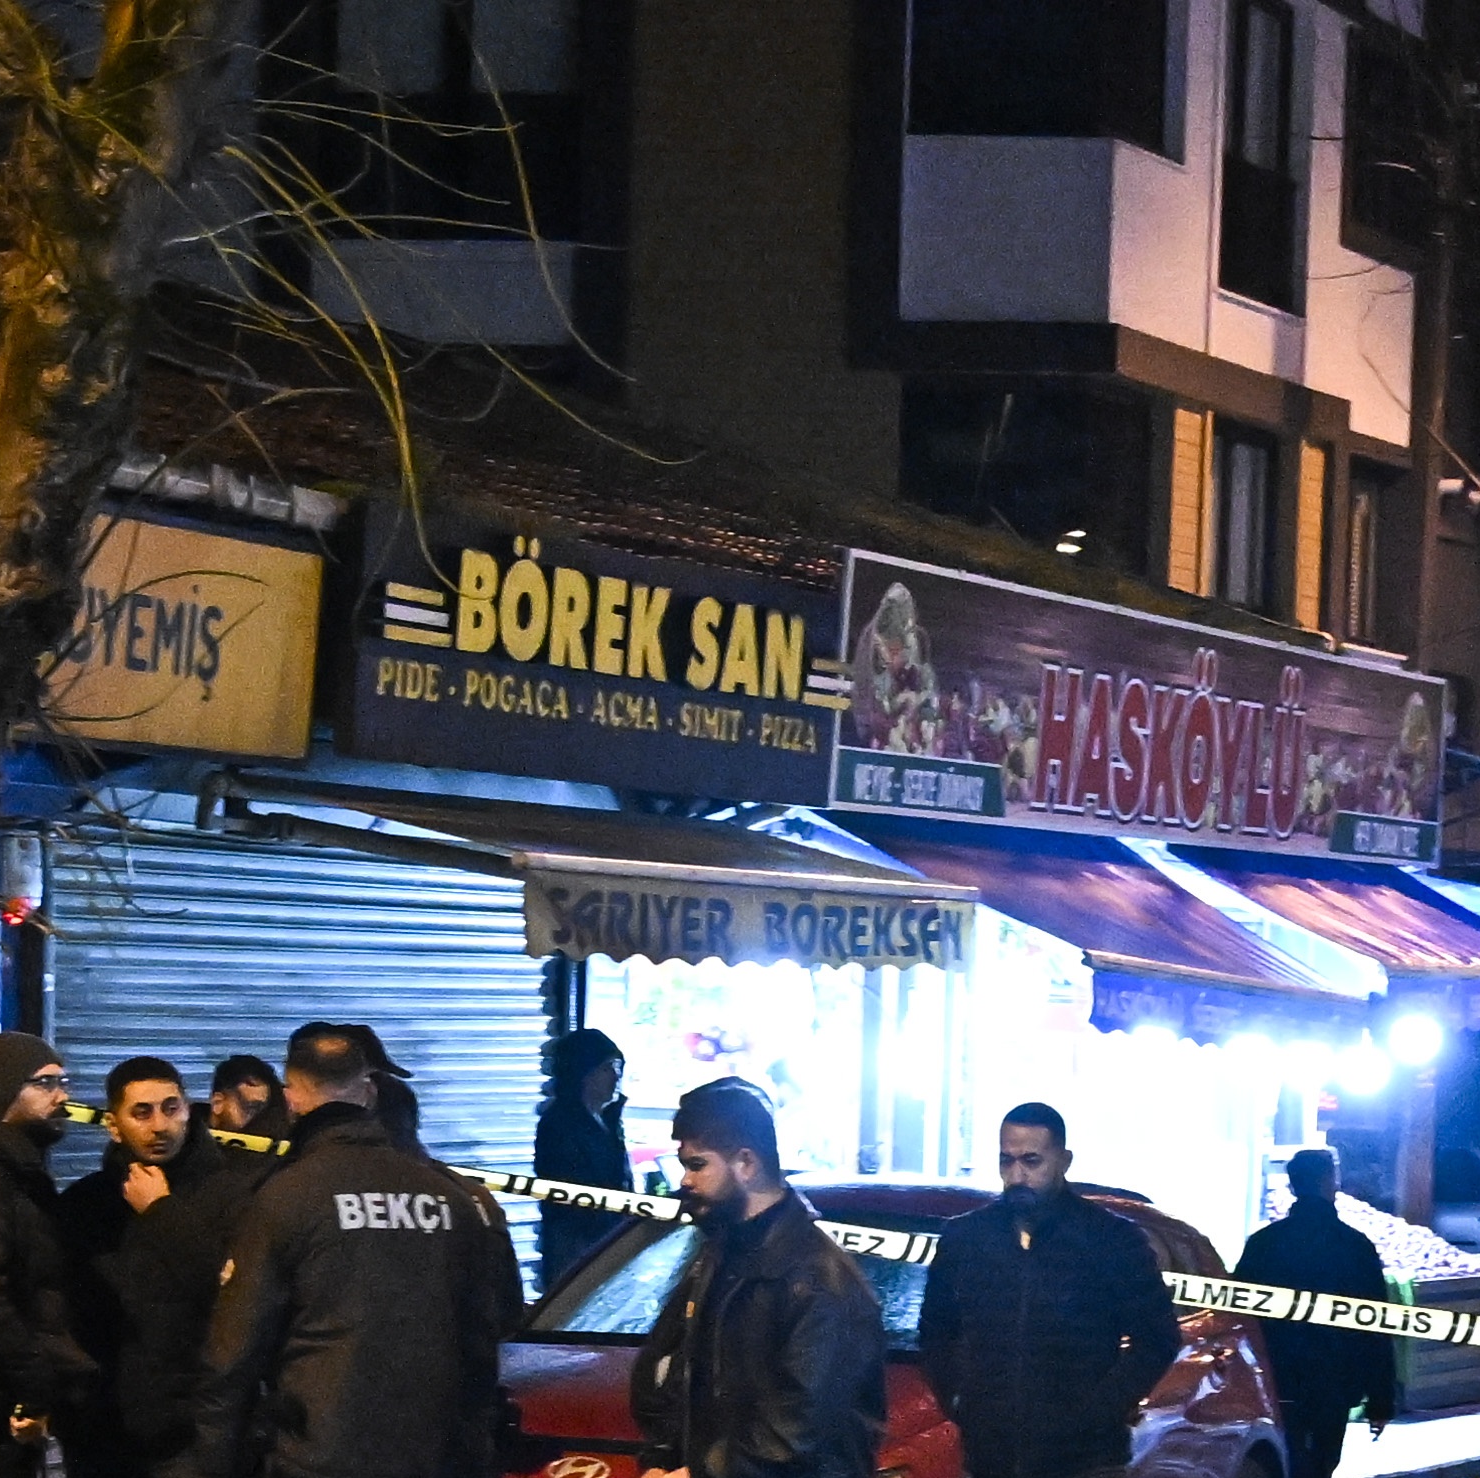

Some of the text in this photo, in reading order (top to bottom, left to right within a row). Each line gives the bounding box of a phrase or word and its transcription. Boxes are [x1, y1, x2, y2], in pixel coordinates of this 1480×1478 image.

[455, 535, 804, 700] BÖREK SAN
[377, 656, 444, 702] PIDE
[760, 713, 817, 753] PIZZA
[1029, 647, 1307, 840] HASKÖYLÜ
[333, 1192, 452, 1234] BEKÇİ
[1330, 1299, 1433, 1334] POLİS
